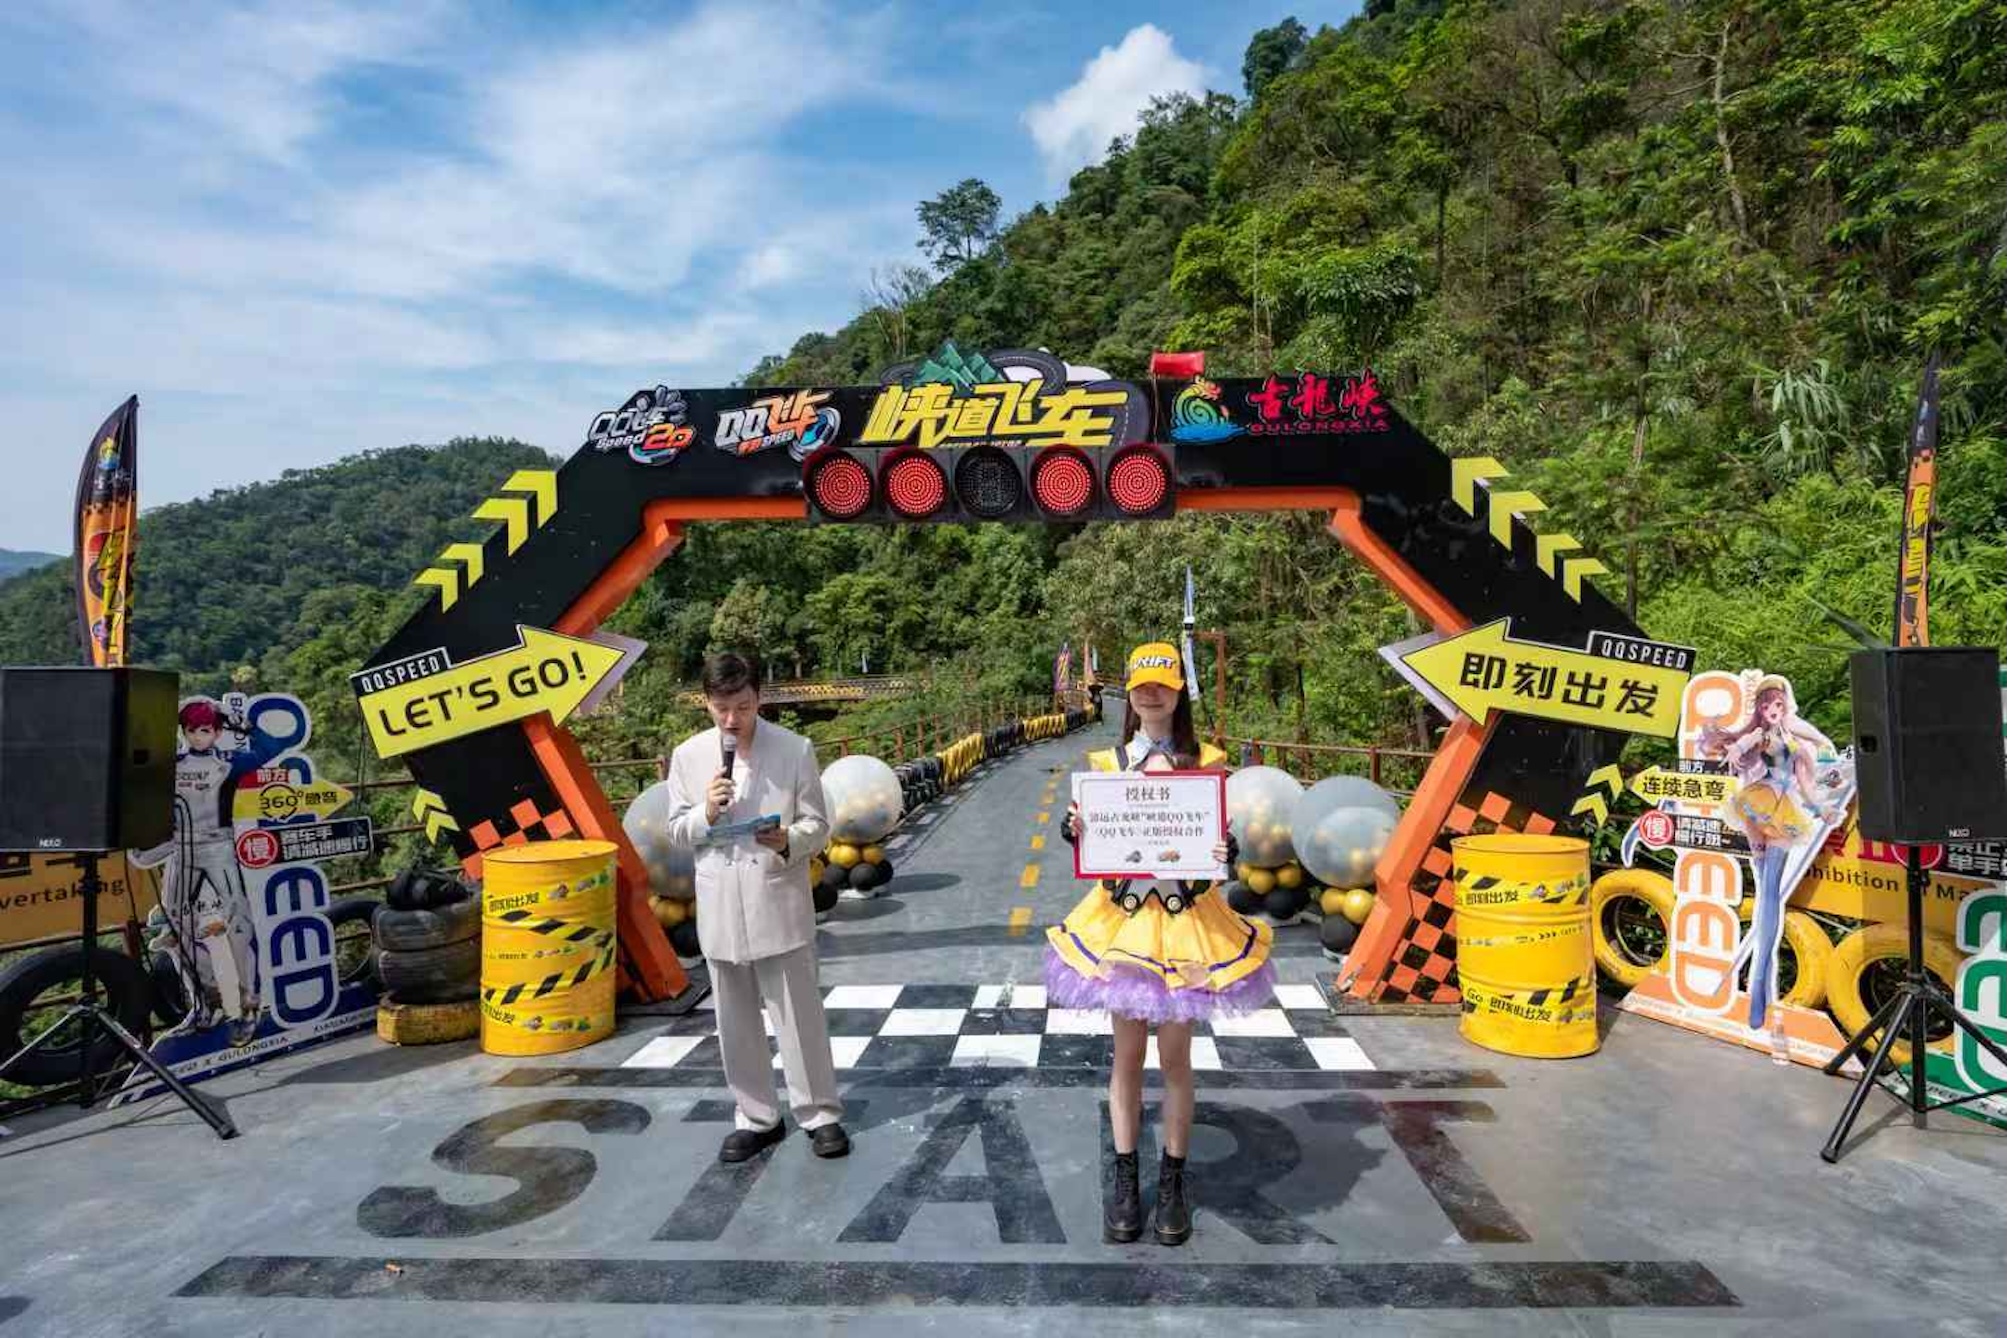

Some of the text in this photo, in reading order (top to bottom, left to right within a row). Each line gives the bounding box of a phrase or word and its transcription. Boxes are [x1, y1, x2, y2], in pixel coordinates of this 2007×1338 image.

[861, 379, 1128, 447] 峡道飞车
[1249, 419, 1390, 434] GULONGXIA
[1602, 638, 1687, 669] QQSPEED
[361, 657, 440, 693] QQSPEED
[1459, 652, 1659, 718] 即刻出发
[379, 651, 587, 737] LET'S GO!
[256, 768, 288, 783] 前方
[1643, 776, 1726, 801] 连续急弯
[1126, 786, 1170, 801] 授权书
[245, 836, 270, 860] 慢
[1490, 997, 1553, 1023] 即刻出发
[355, 1097, 1532, 1245] START
